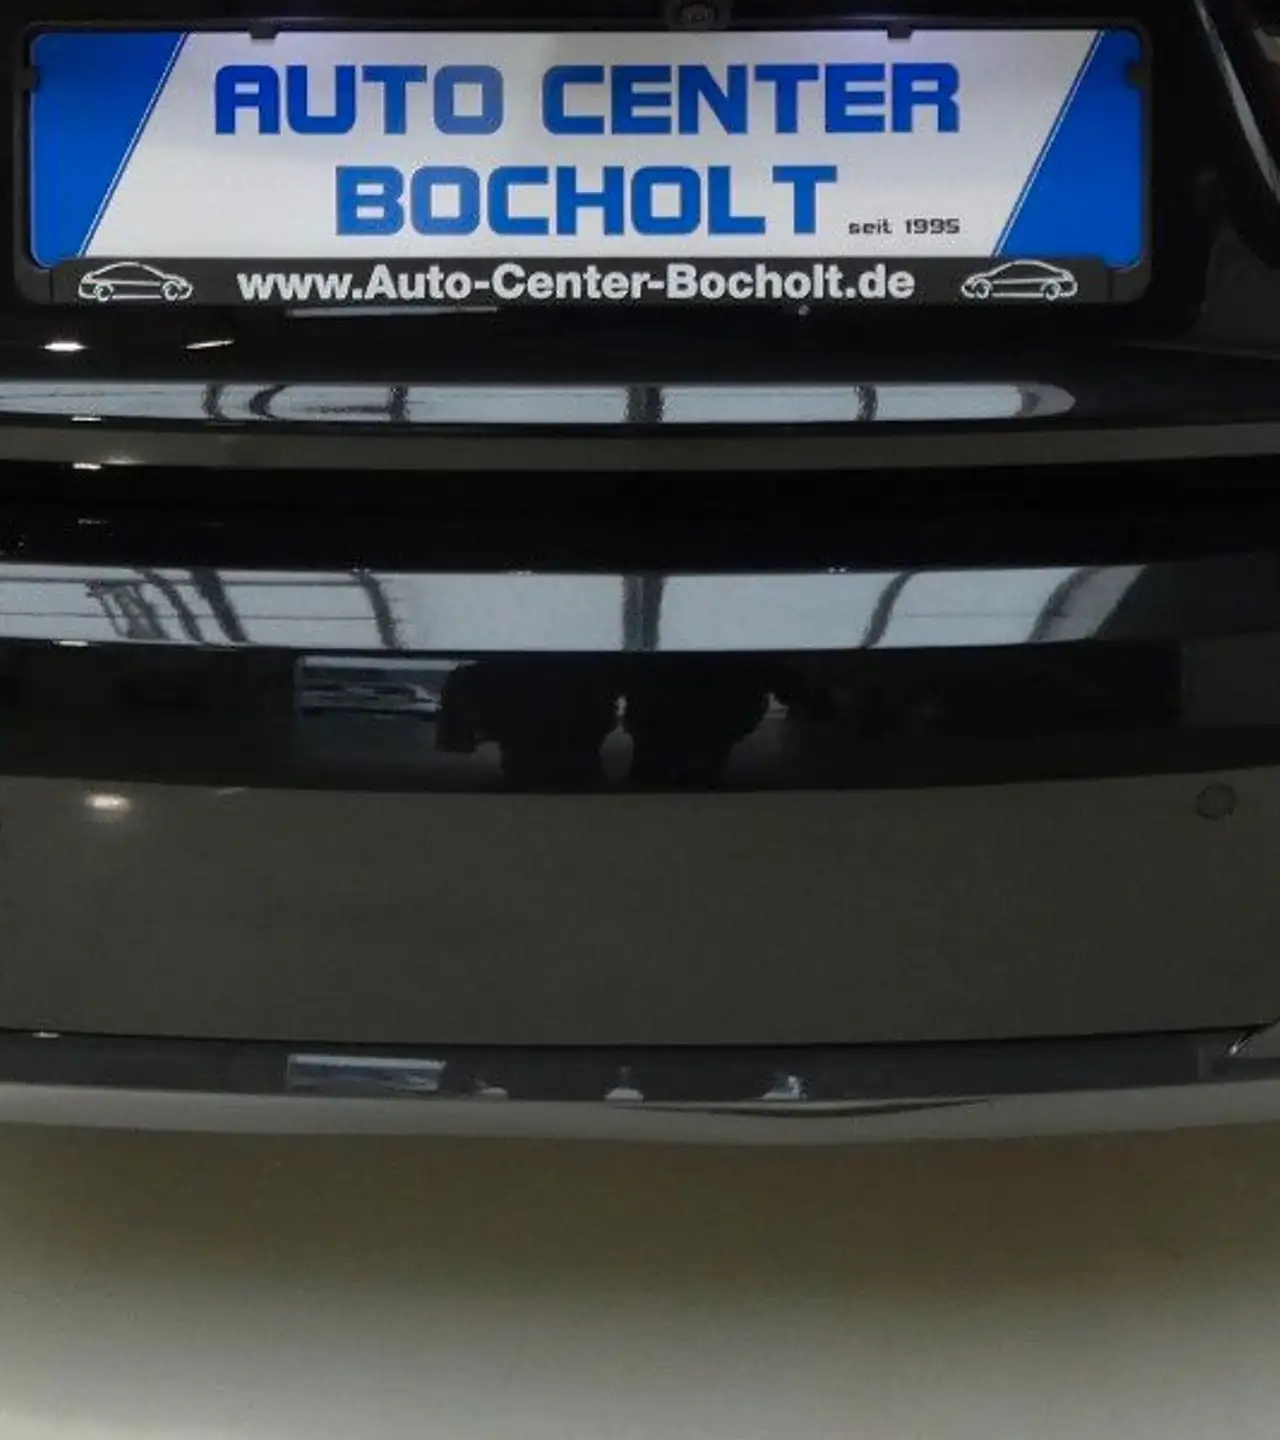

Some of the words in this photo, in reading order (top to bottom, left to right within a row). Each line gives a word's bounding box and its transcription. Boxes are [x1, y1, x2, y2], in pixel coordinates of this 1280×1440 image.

[214, 63, 505, 136] AUTO
[541, 62, 961, 136] CENTER
[335, 164, 838, 237] BOCHOLT
[848, 218, 894, 235] seit
[904, 217, 961, 236] 1995
[236, 262, 916, 301] www.Auto-Center-Bocholt.de
